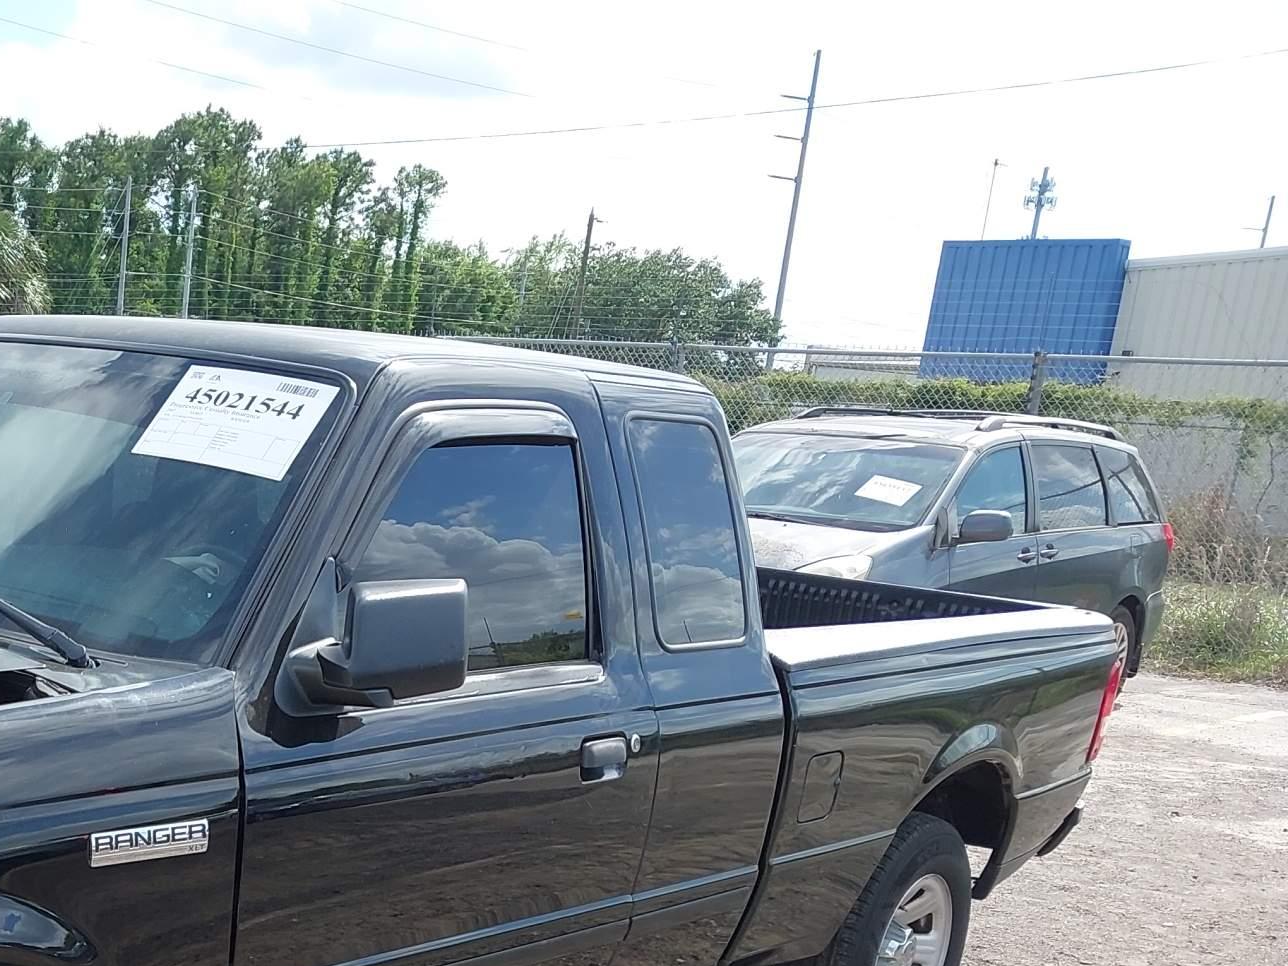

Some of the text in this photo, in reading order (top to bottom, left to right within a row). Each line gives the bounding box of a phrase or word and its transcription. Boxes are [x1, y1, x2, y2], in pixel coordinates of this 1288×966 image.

[185, 387, 306, 421] 45021544
[93, 823, 208, 853] RANGER
[187, 844, 206, 852] XLT
